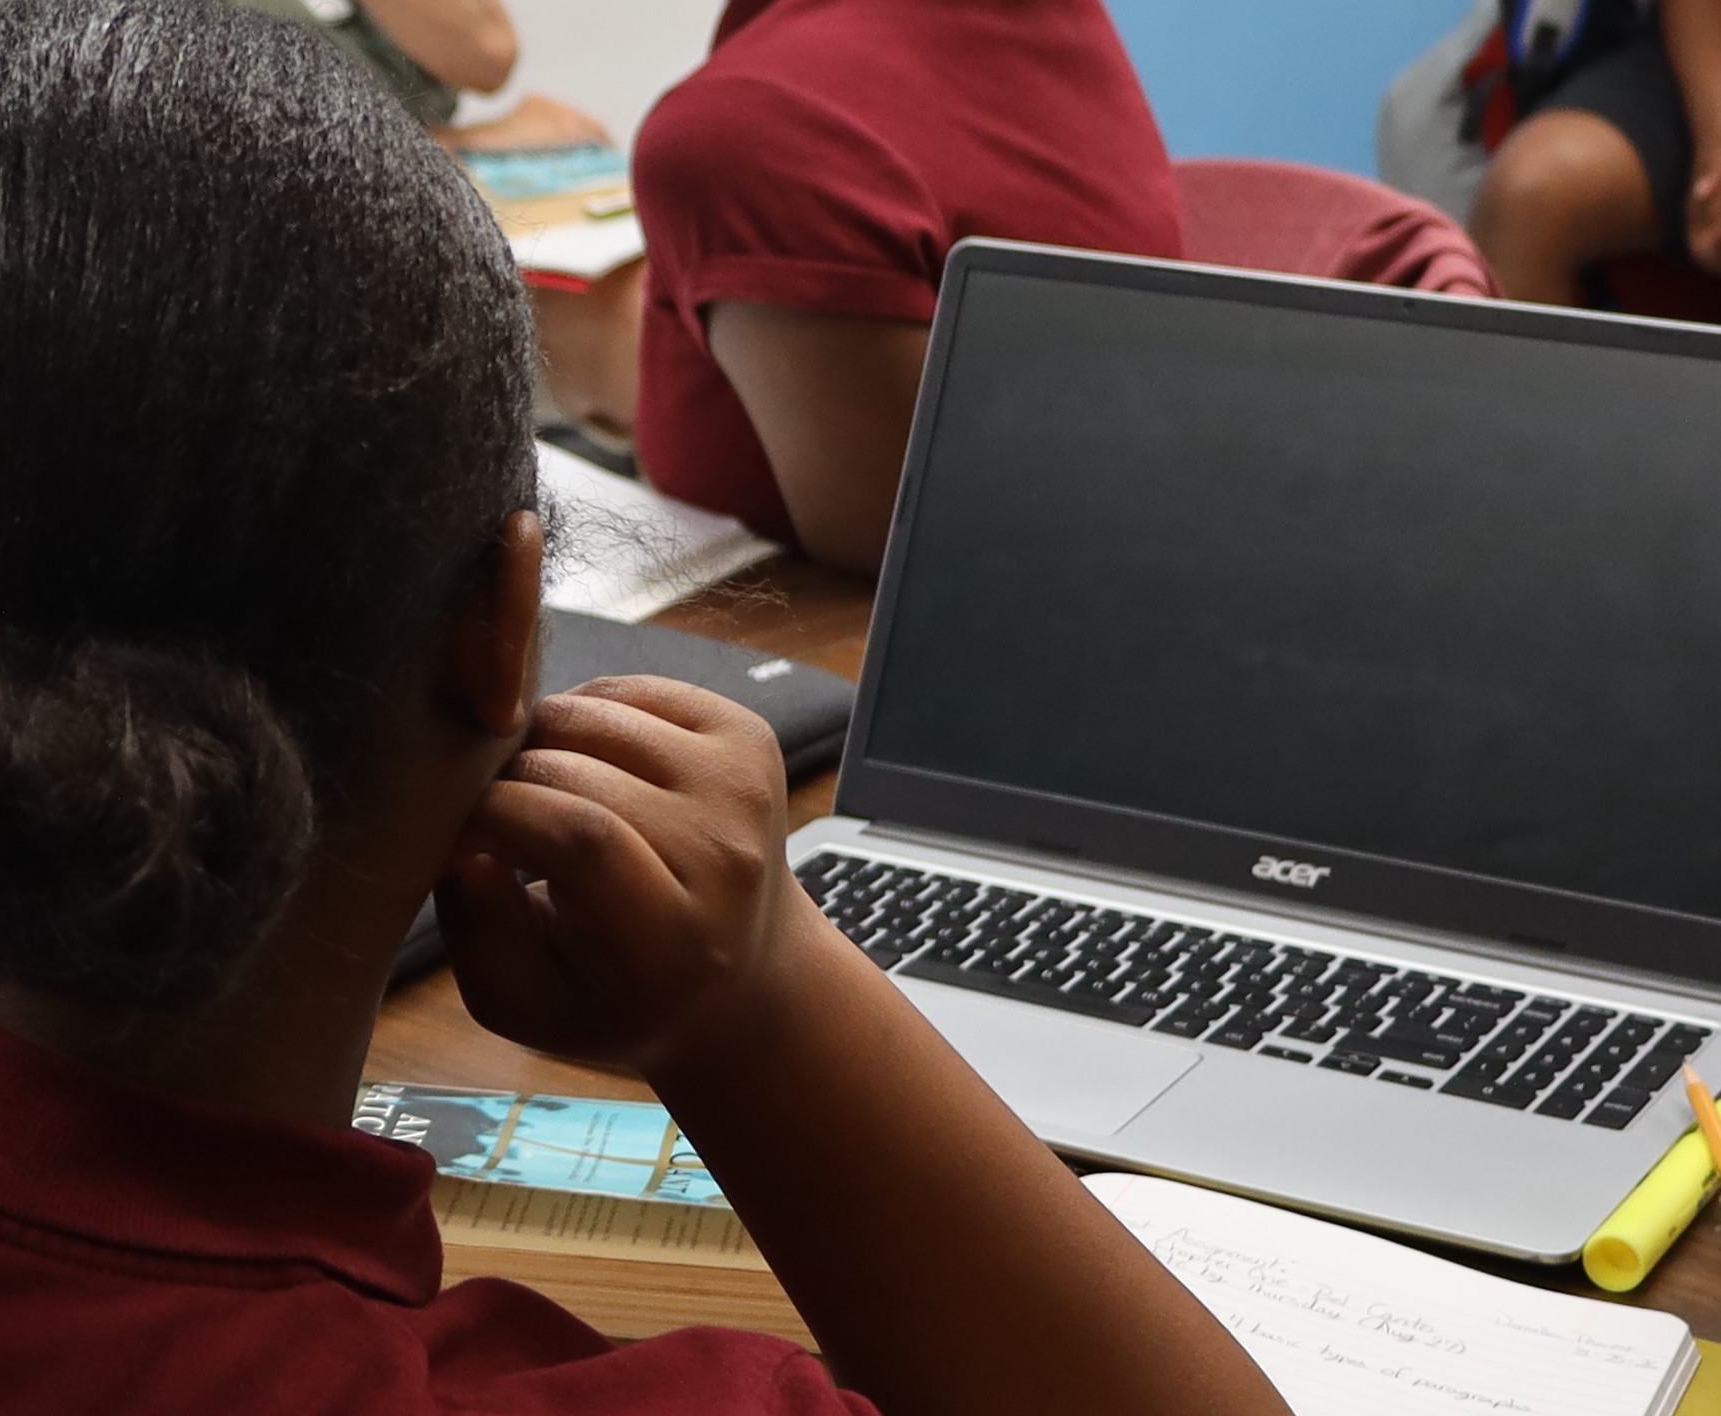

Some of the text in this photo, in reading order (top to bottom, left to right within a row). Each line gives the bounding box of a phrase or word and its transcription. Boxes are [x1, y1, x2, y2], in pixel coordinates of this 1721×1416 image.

[1251, 854, 1332, 889] acer
[351, 1084, 407, 1136] PATC
[1366, 1302, 1436, 1334] Canto
[1250, 1321, 1302, 1350] basic
[1318, 1344, 1369, 1370] types
[1379, 1366, 1412, 1380] of
[1411, 1376, 1535, 1414] paragraphs
